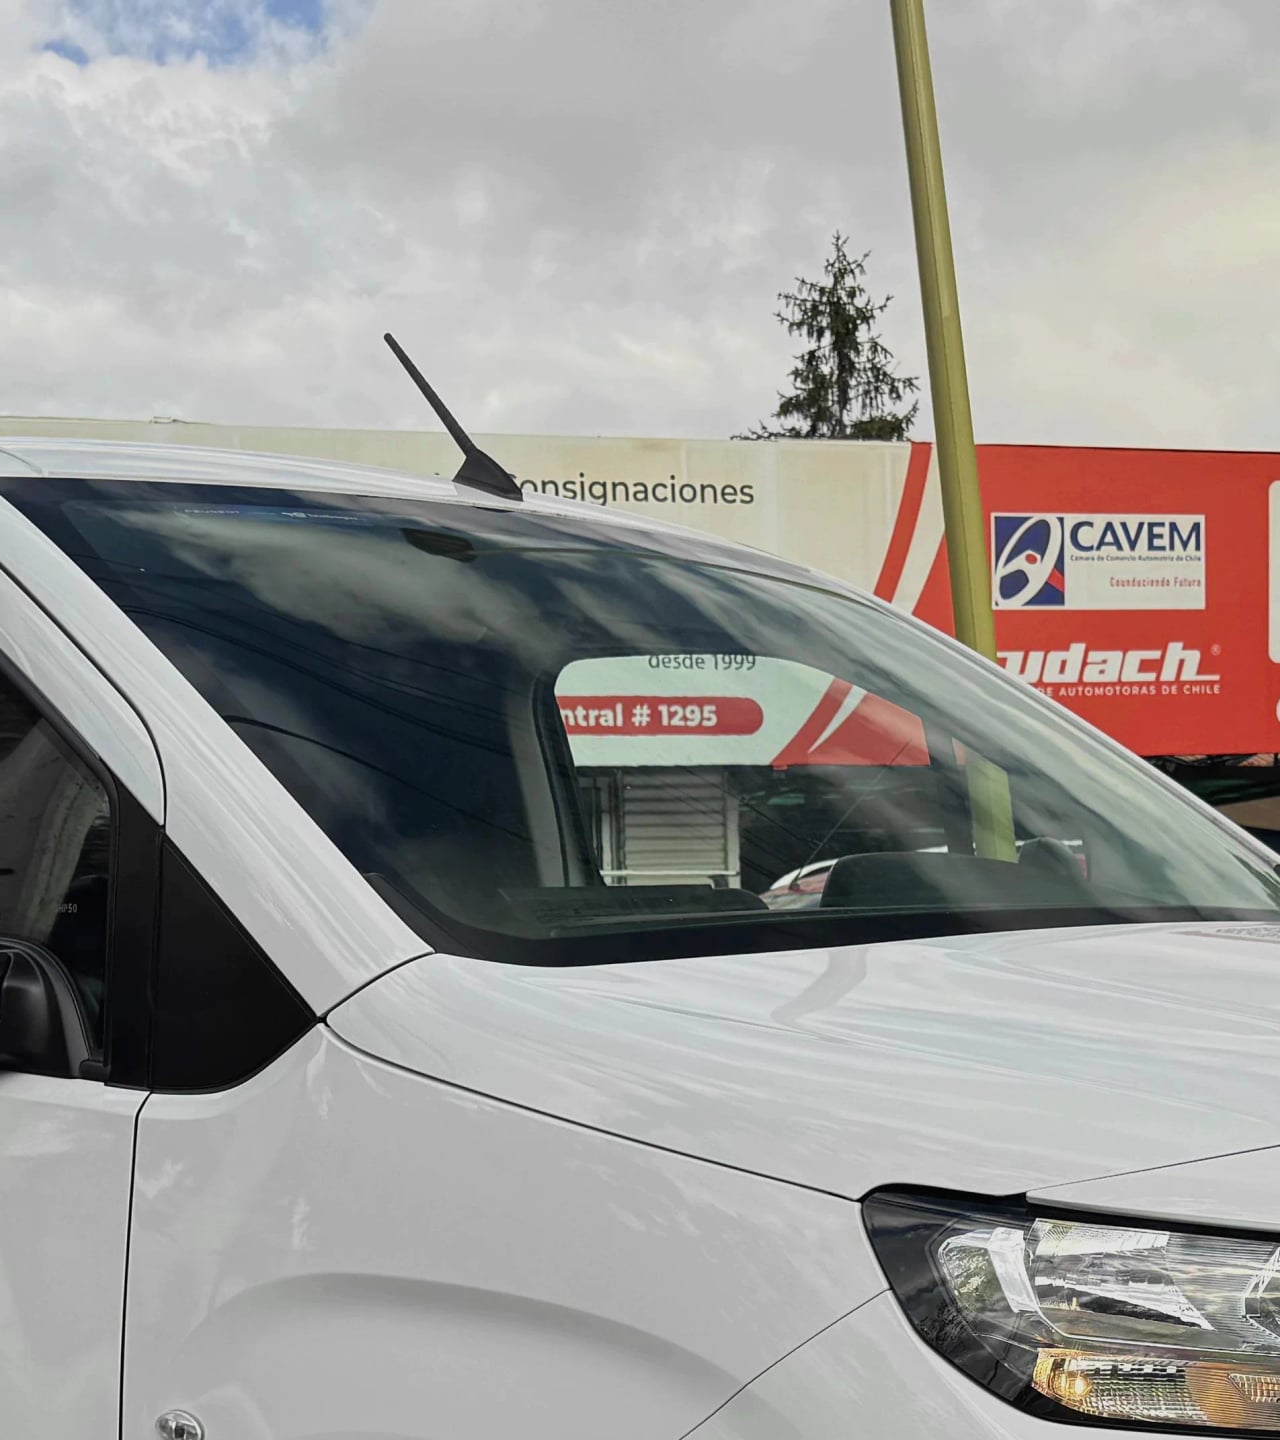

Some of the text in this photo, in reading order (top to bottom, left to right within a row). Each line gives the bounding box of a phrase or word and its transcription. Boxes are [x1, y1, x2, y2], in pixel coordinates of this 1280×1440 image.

[507, 472, 755, 507] onsignaciones
[1070, 520, 1202, 552] CAVEM
[648, 654, 756, 671] desde 1999
[1058, 684, 1156, 697] AUTOMOTORAS
[1161, 684, 1178, 695] DE
[1183, 683, 1221, 694] CHILE
[658, 704, 718, 727] 1295
